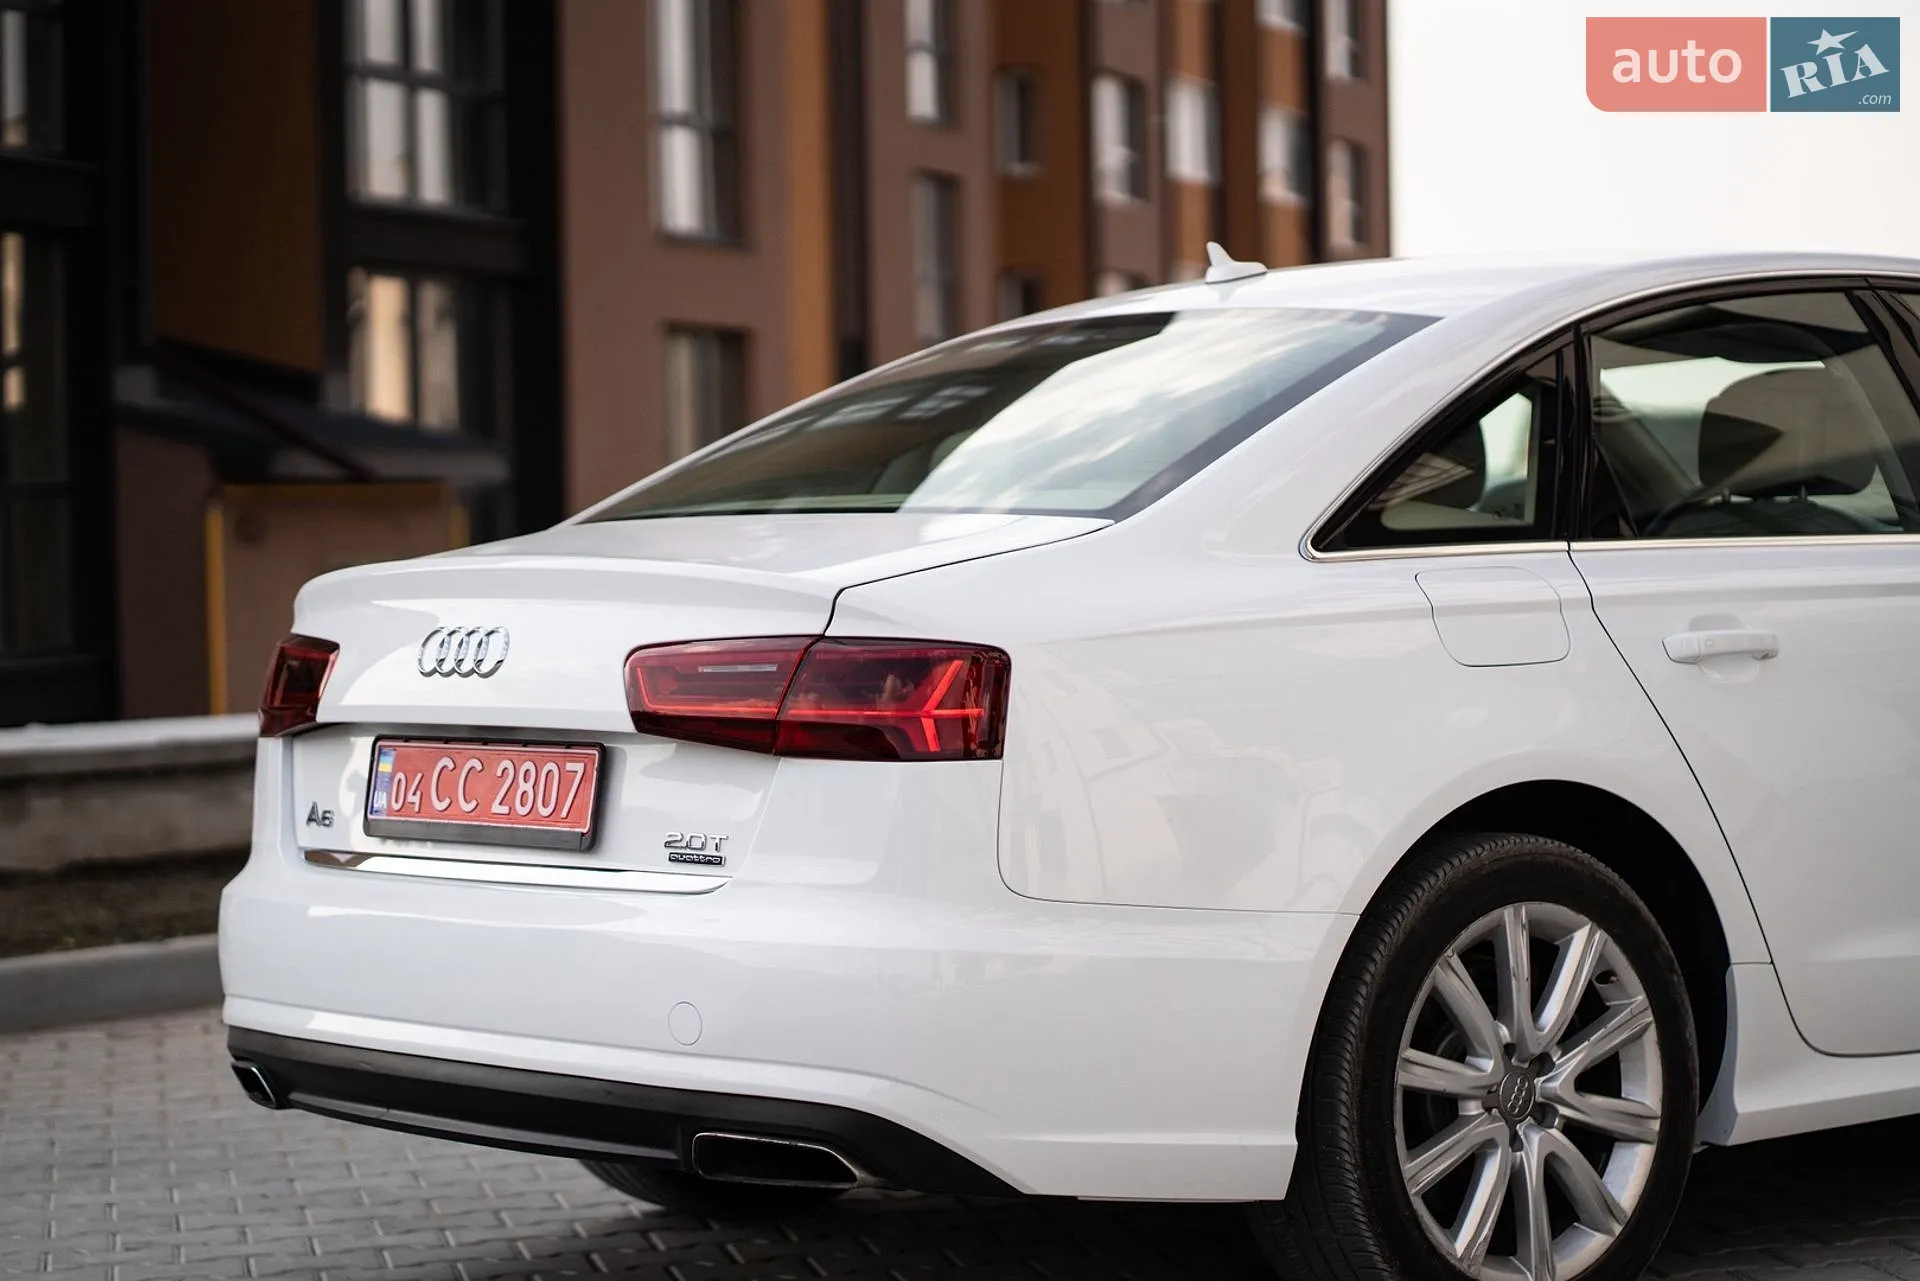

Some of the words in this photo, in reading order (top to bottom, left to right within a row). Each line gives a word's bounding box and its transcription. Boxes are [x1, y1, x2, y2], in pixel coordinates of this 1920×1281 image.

[391, 772, 423, 813] 04
[430, 756, 484, 814] CC
[491, 758, 587, 819] 2807
[373, 790, 387, 809] UA
[306, 801, 335, 827] A6
[669, 853, 722, 864] quattro
